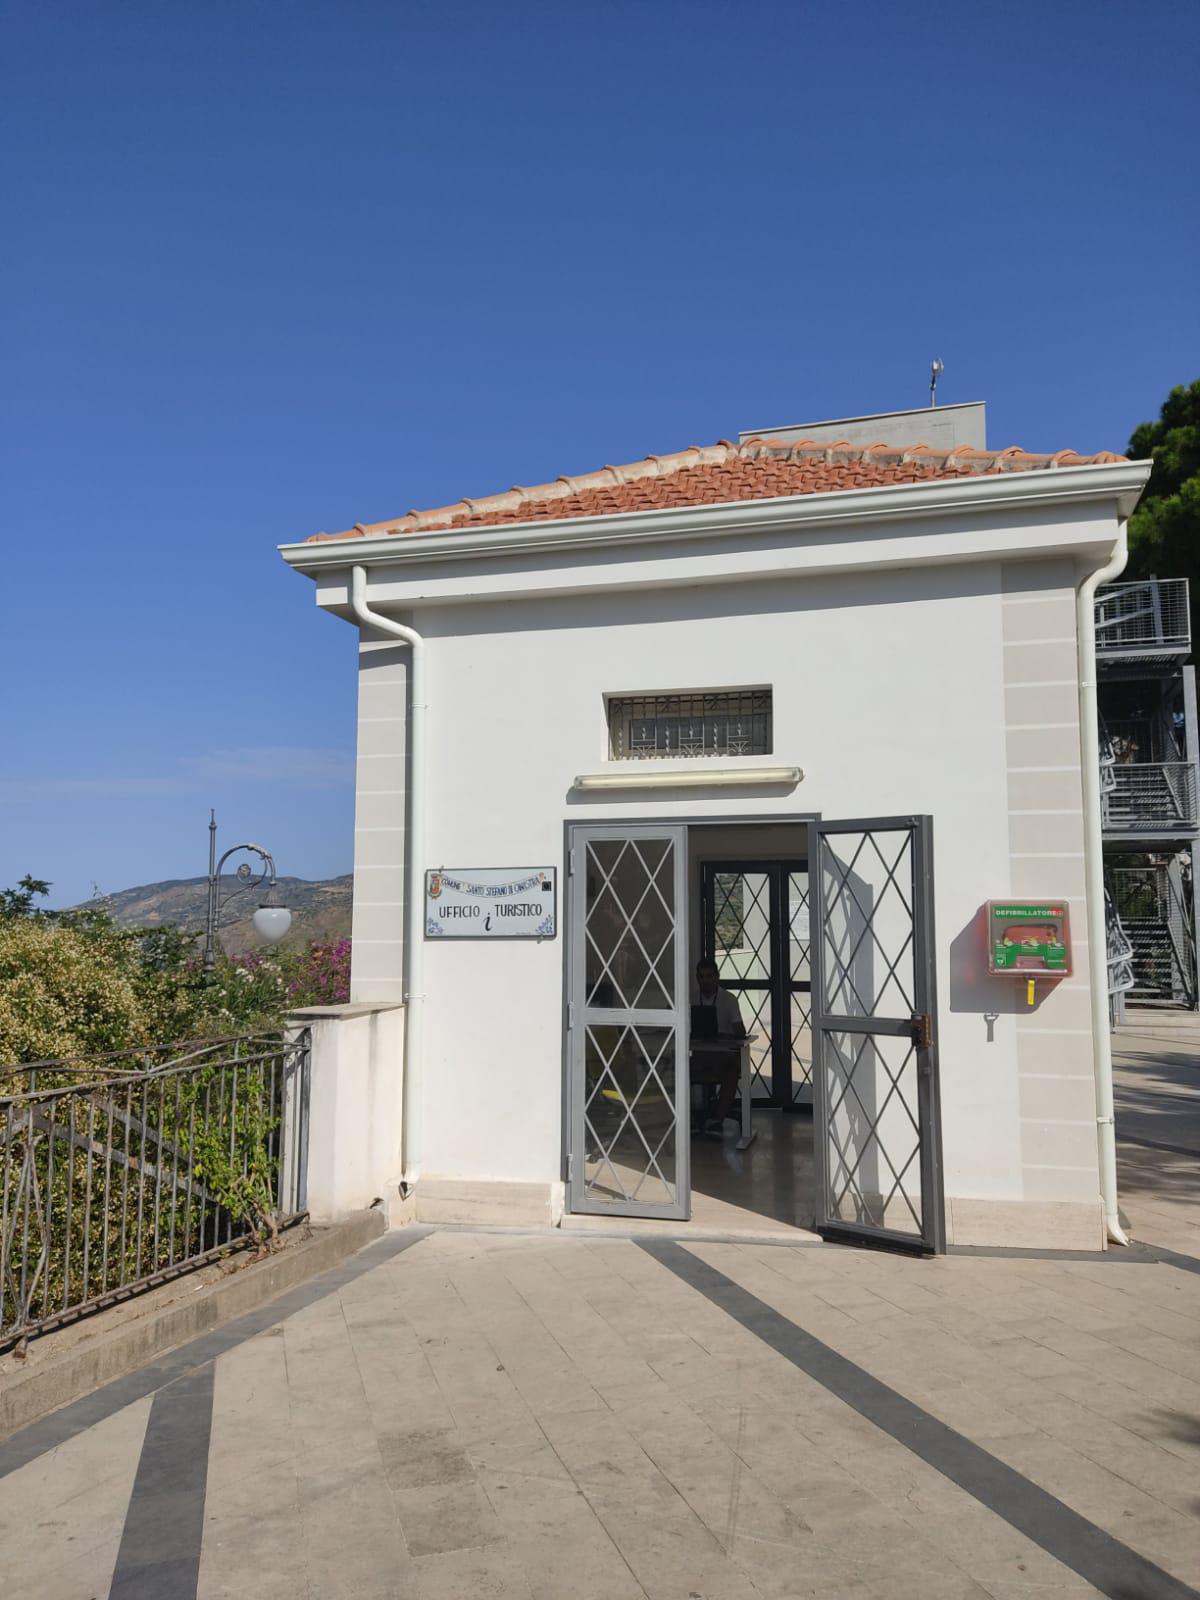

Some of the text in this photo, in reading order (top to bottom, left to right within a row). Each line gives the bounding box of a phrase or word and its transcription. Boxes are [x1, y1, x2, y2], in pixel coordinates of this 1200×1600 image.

[466, 884, 485, 895] SANTO
[486, 887, 507, 896] STEFANO
[439, 903, 542, 918] UFFICIO TURISTICO
